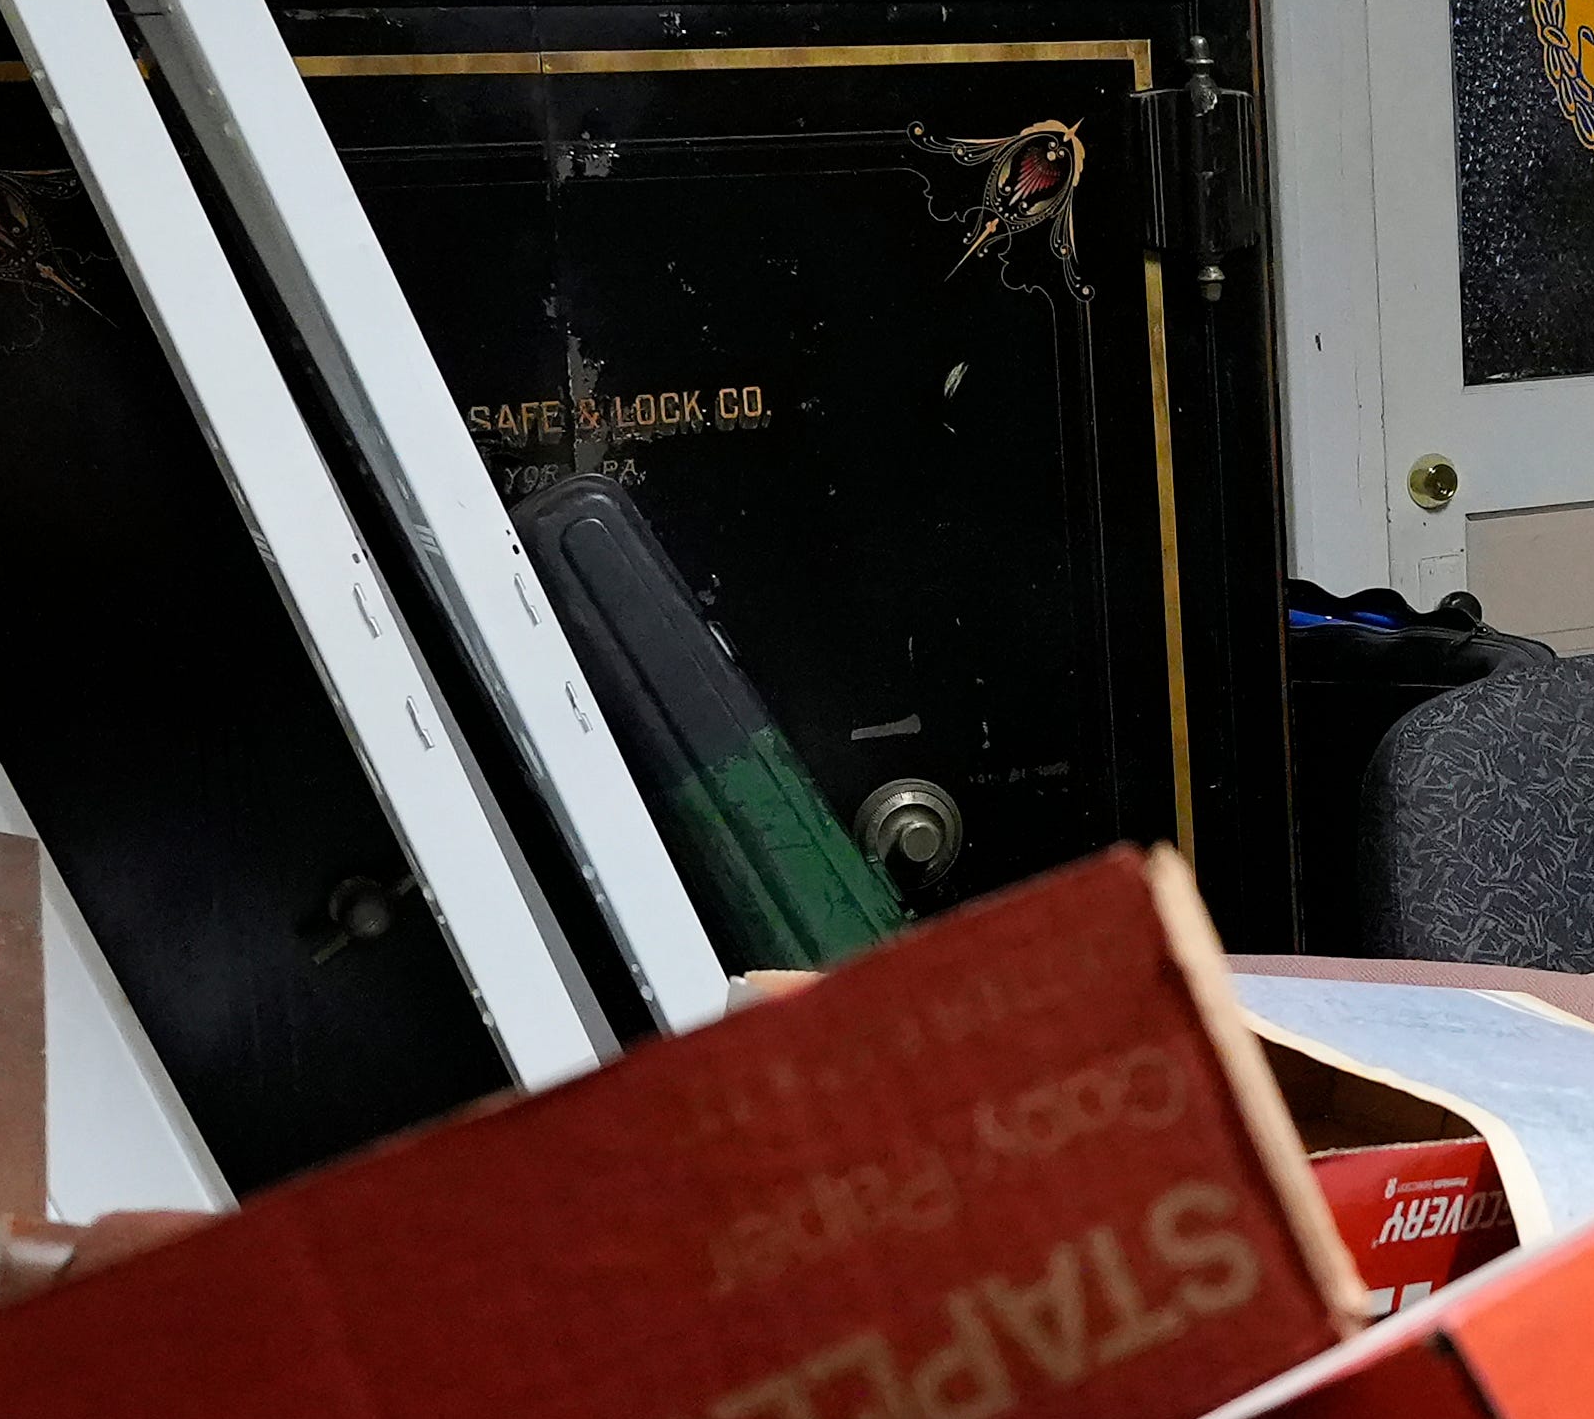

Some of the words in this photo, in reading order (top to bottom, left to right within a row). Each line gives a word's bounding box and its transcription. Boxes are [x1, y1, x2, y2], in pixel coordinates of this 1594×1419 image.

[468, 399, 564, 434] SAFE
[578, 398, 601, 430] &
[612, 390, 703, 428] LOCK
[718, 386, 772, 419] CO.
[505, 463, 560, 495] YOR
